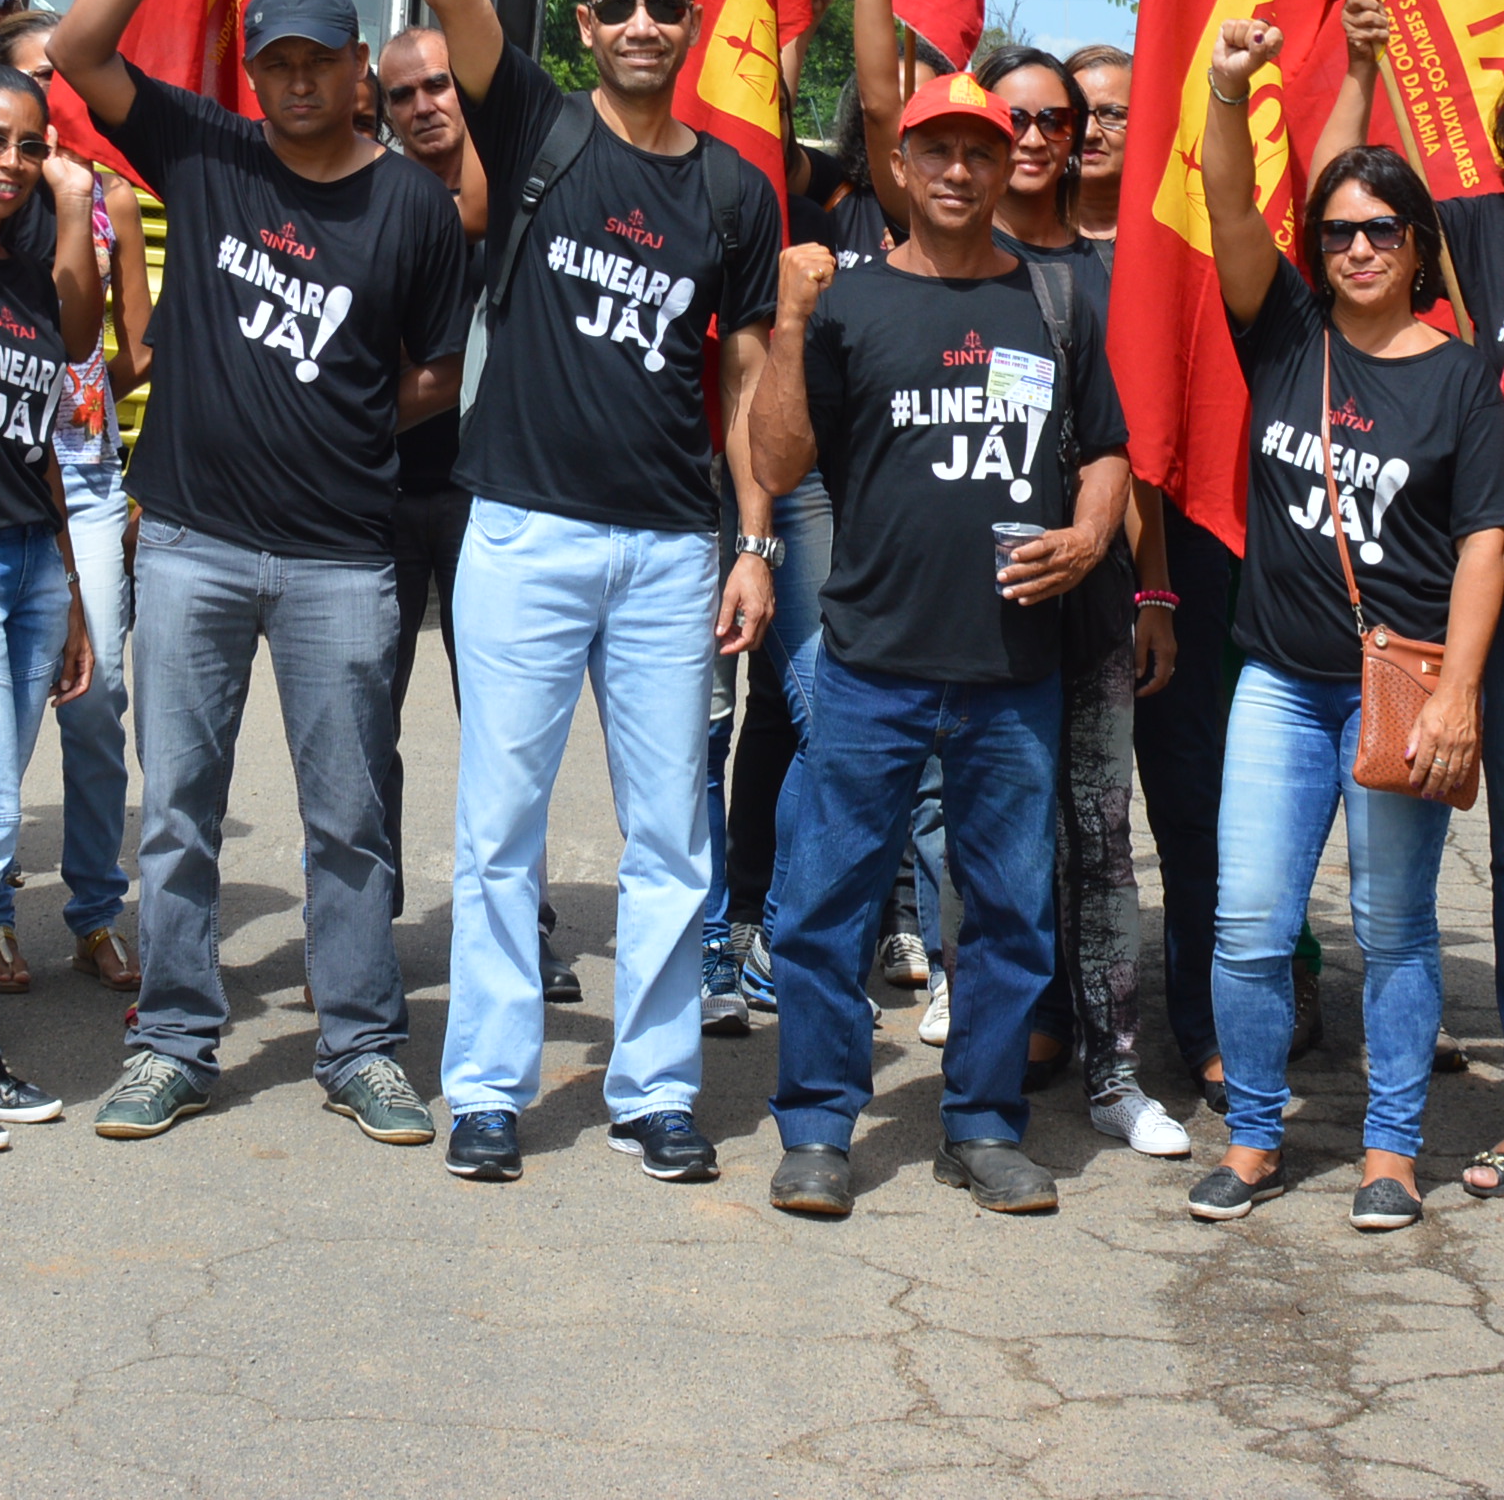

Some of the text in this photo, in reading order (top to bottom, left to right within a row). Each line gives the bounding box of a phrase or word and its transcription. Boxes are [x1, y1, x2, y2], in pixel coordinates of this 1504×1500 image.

[1403, 72, 1425, 102] DA
[1404, 11, 1449, 94] SERVIÇOS
[1436, 95, 1481, 190] AUXILIARES
[1410, 101, 1442, 159] BAHIA
[259, 228, 317, 261] SINTAJ
[603, 216, 665, 250] SINTAJ
[217, 234, 325, 318] #LINEAR
[547, 234, 671, 307] #LINEAR
[890, 386, 1028, 428] #LINEAR
[1261, 419, 1380, 491] #LINEAR
